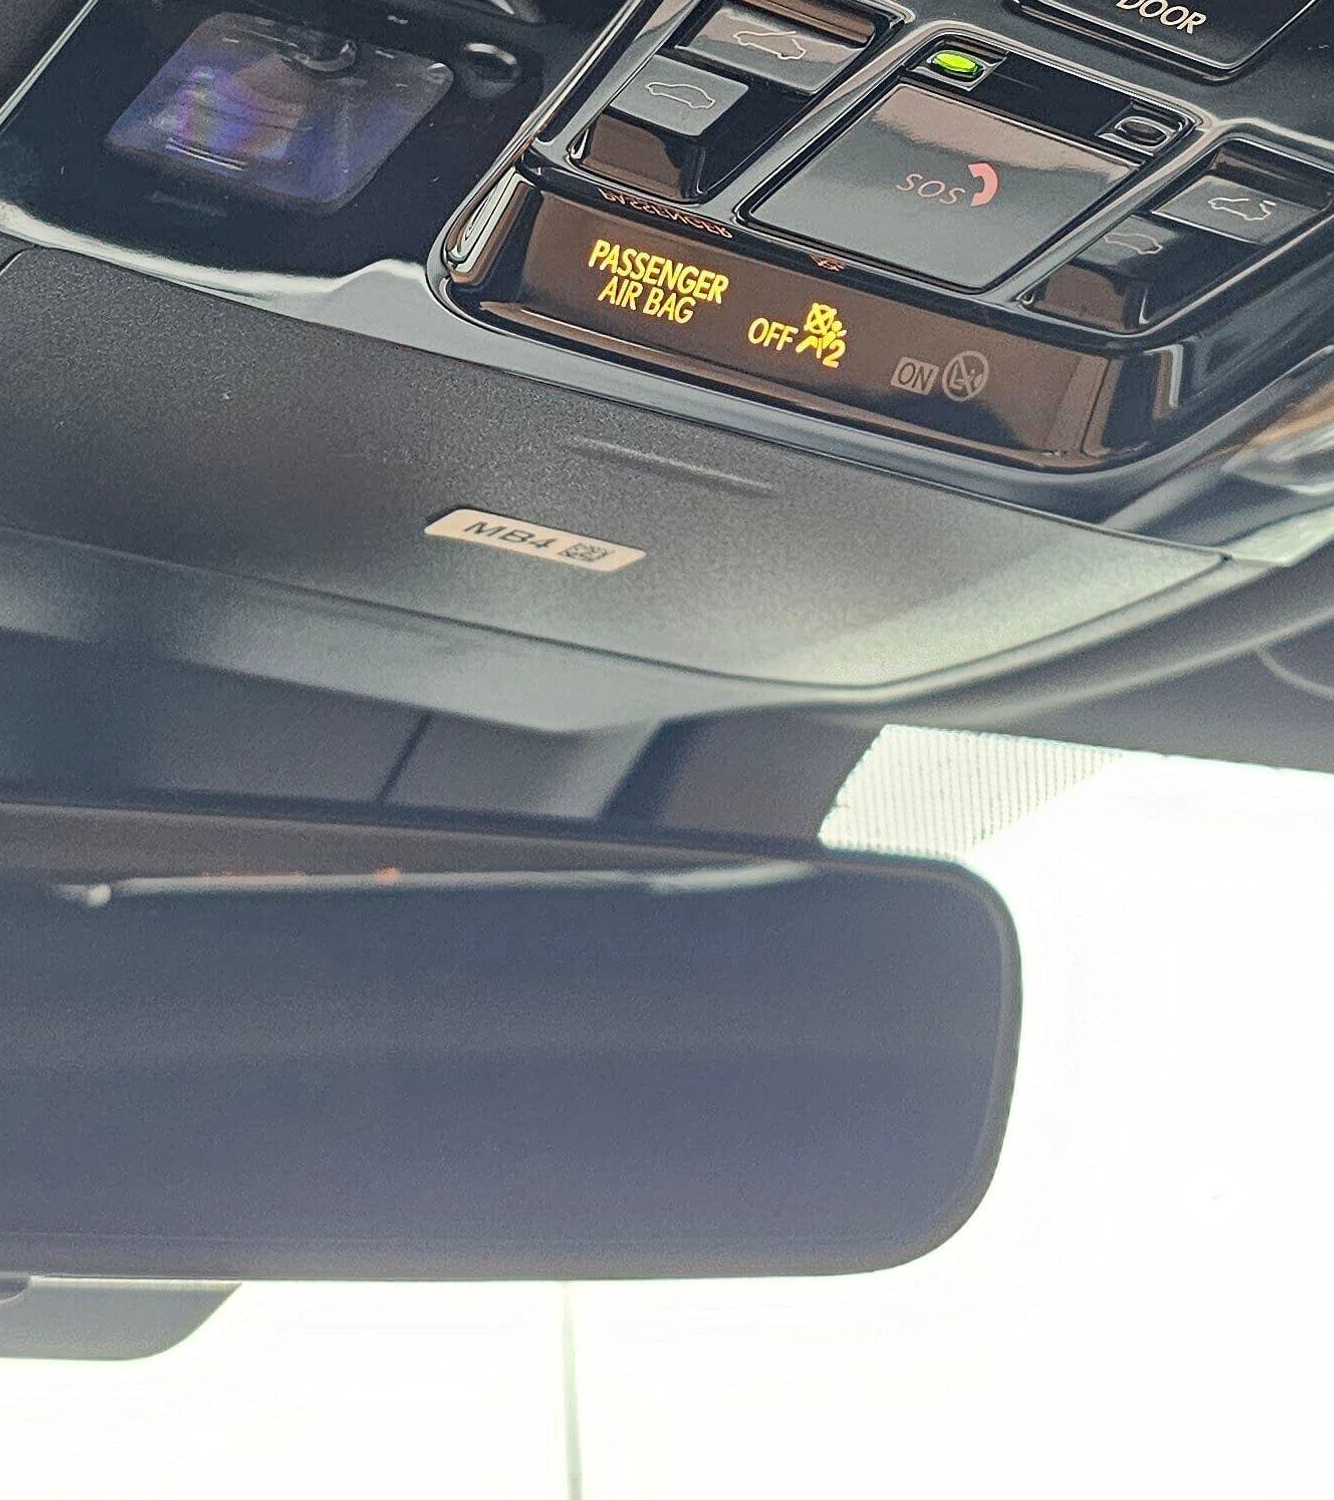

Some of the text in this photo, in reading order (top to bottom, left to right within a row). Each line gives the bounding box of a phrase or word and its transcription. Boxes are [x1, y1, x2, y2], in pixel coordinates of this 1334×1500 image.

[895, 173, 966, 206] SOS
[588, 239, 730, 305] PASSENGER
[598, 275, 697, 324] AIR BAG
[747, 316, 800, 352] OFF
[895, 361, 934, 392] ON
[464, 521, 559, 550] MB4
